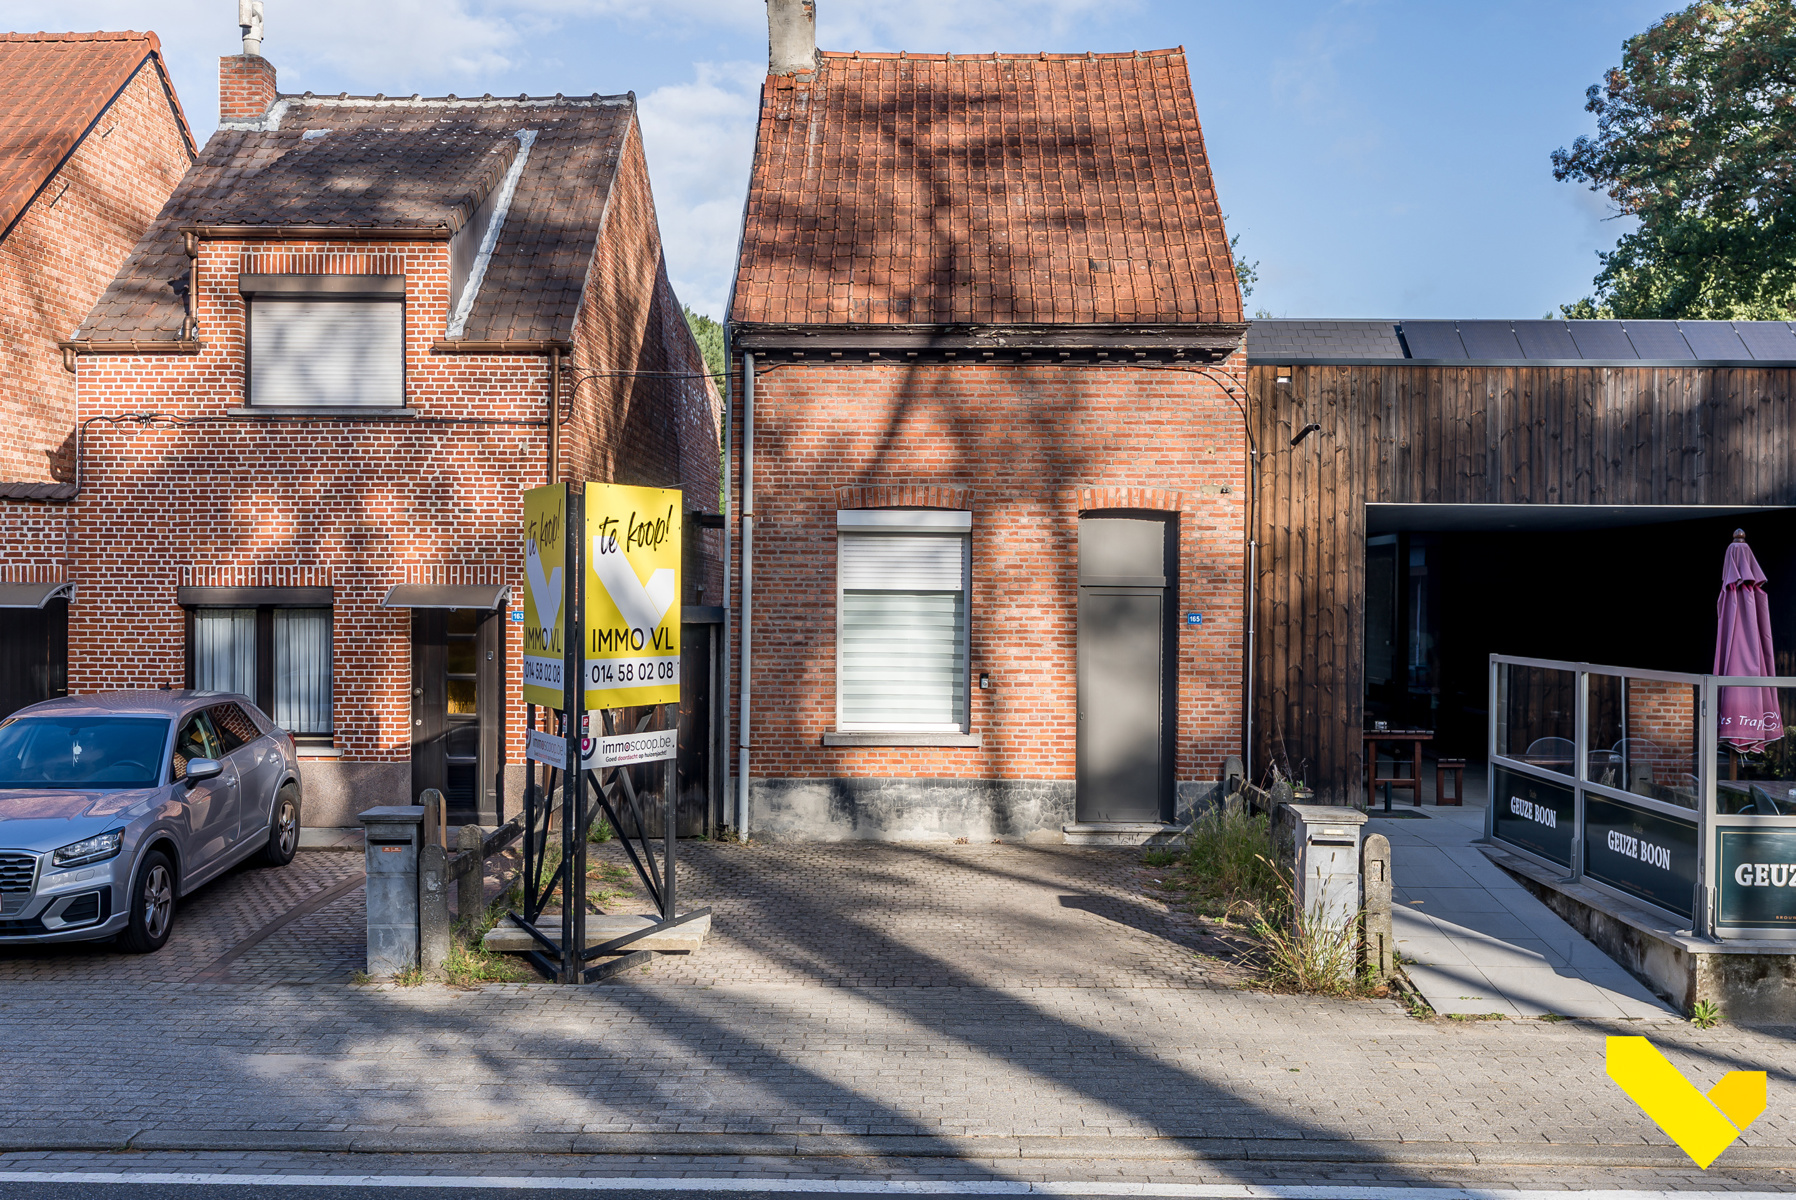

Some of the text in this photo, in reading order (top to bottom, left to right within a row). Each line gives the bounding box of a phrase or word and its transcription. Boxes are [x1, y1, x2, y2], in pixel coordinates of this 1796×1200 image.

[528, 498, 562, 556] te koop!
[599, 504, 673, 554] te koop!
[525, 627, 561, 653] IMMO VL
[592, 627, 674, 652] IMMO VL
[525, 661, 561, 683] 014 58 02 08
[591, 661, 673, 683] 014 58 02 08
[602, 735, 671, 754] immoscoop.be
[1510, 796, 1557, 829] GEUZE BOON
[1607, 829, 1671, 871] GEUZE BOON
